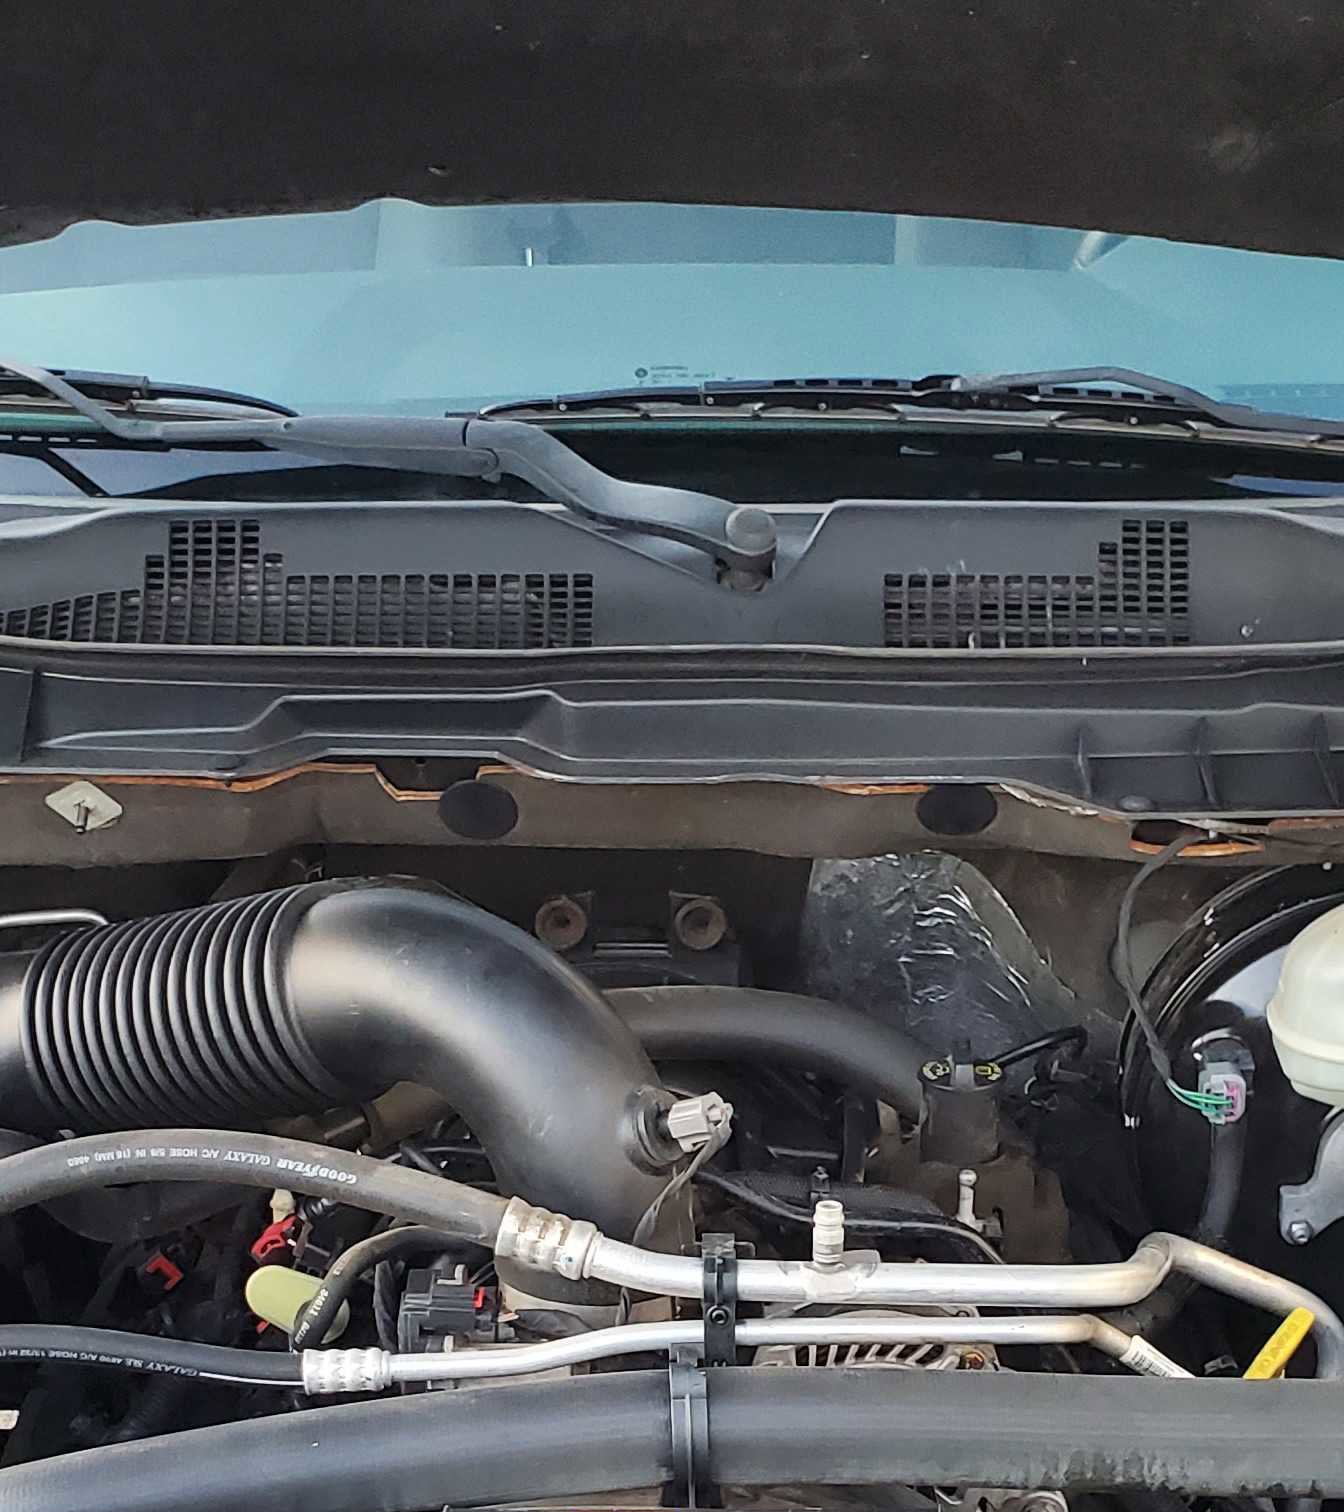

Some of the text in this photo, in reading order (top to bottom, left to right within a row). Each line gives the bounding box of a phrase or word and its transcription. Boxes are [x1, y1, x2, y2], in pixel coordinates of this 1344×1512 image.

[169, 1148, 198, 1158] HOSE
[202, 1150, 219, 1159] A/C
[224, 1152, 271, 1167] GALAXY
[276, 1157, 357, 1185] GOODYEAR
[145, 1362, 198, 1377] GALAXY
